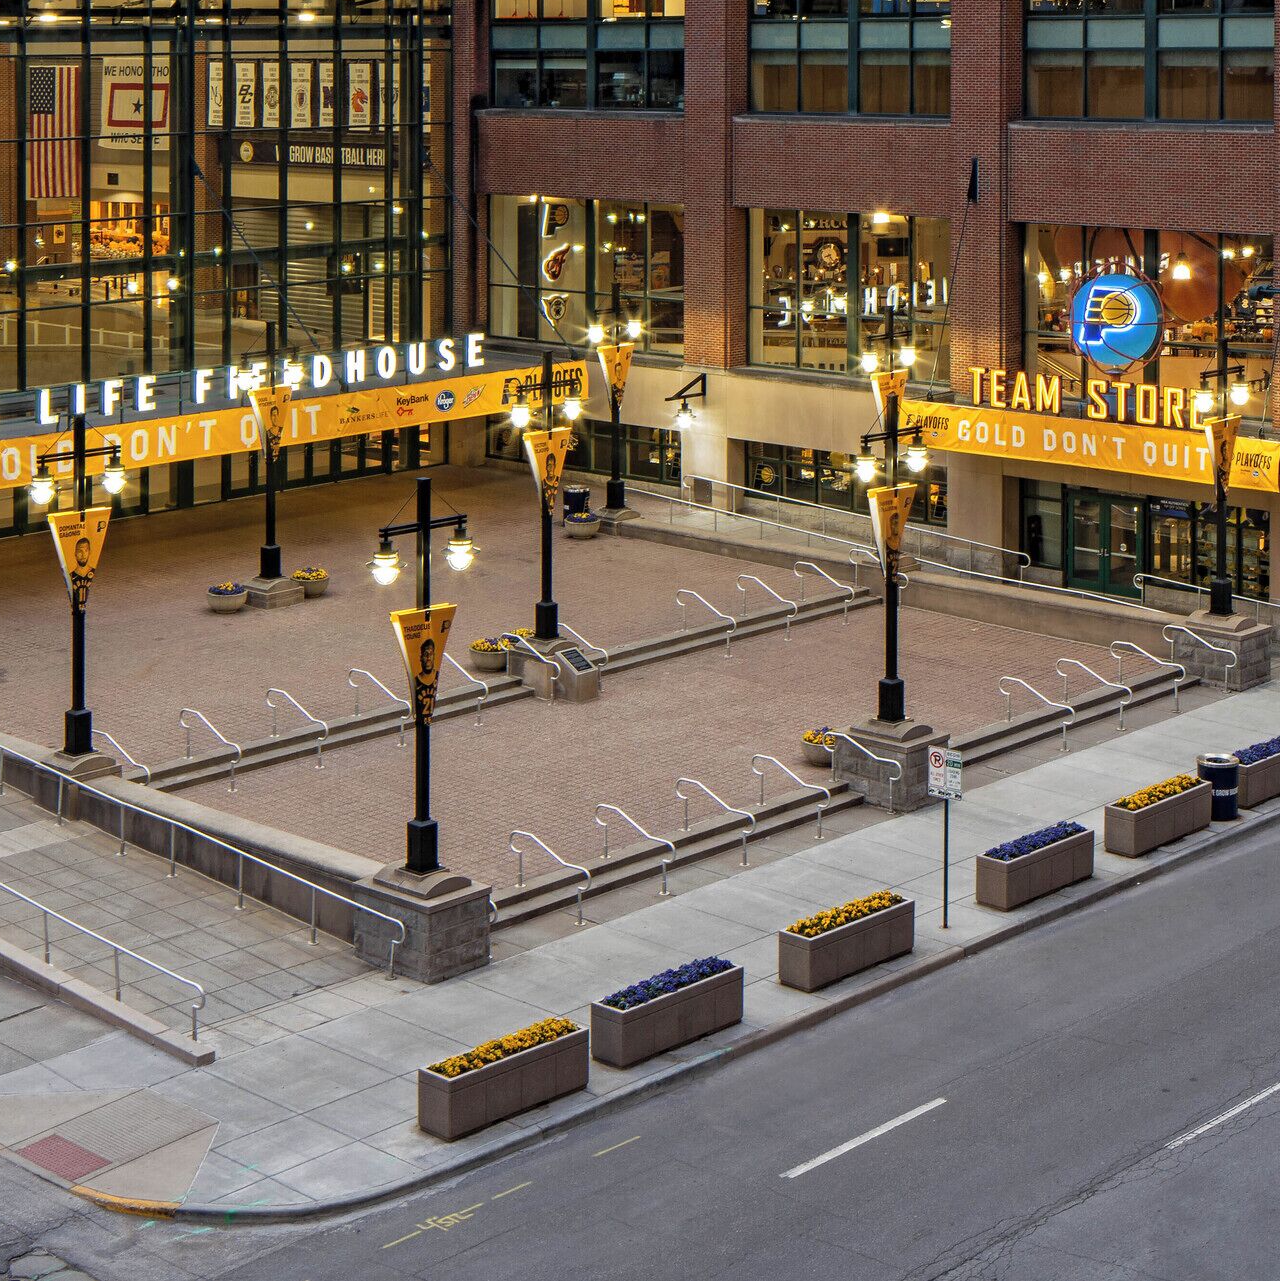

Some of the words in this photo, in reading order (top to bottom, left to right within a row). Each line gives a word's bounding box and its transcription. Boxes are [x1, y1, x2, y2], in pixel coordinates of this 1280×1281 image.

[104, 66, 117, 76] WE
[119, 66, 144, 77] HONO
[289, 145, 314, 163] GROW
[38, 375, 157, 425] LIFE
[396, 393, 430, 407] KeyBank
[968, 366, 1063, 414] TEAM
[1087, 379, 1206, 430] STORE
[240, 404, 322, 449] QIT
[916, 414, 950, 431] PLAYOFFS
[957, 419, 1026, 448] GOLD
[1043, 428, 1126, 460] DON'T
[1143, 441, 1210, 471] QUIT
[1235, 451, 1272, 470] PLAYOFFS
